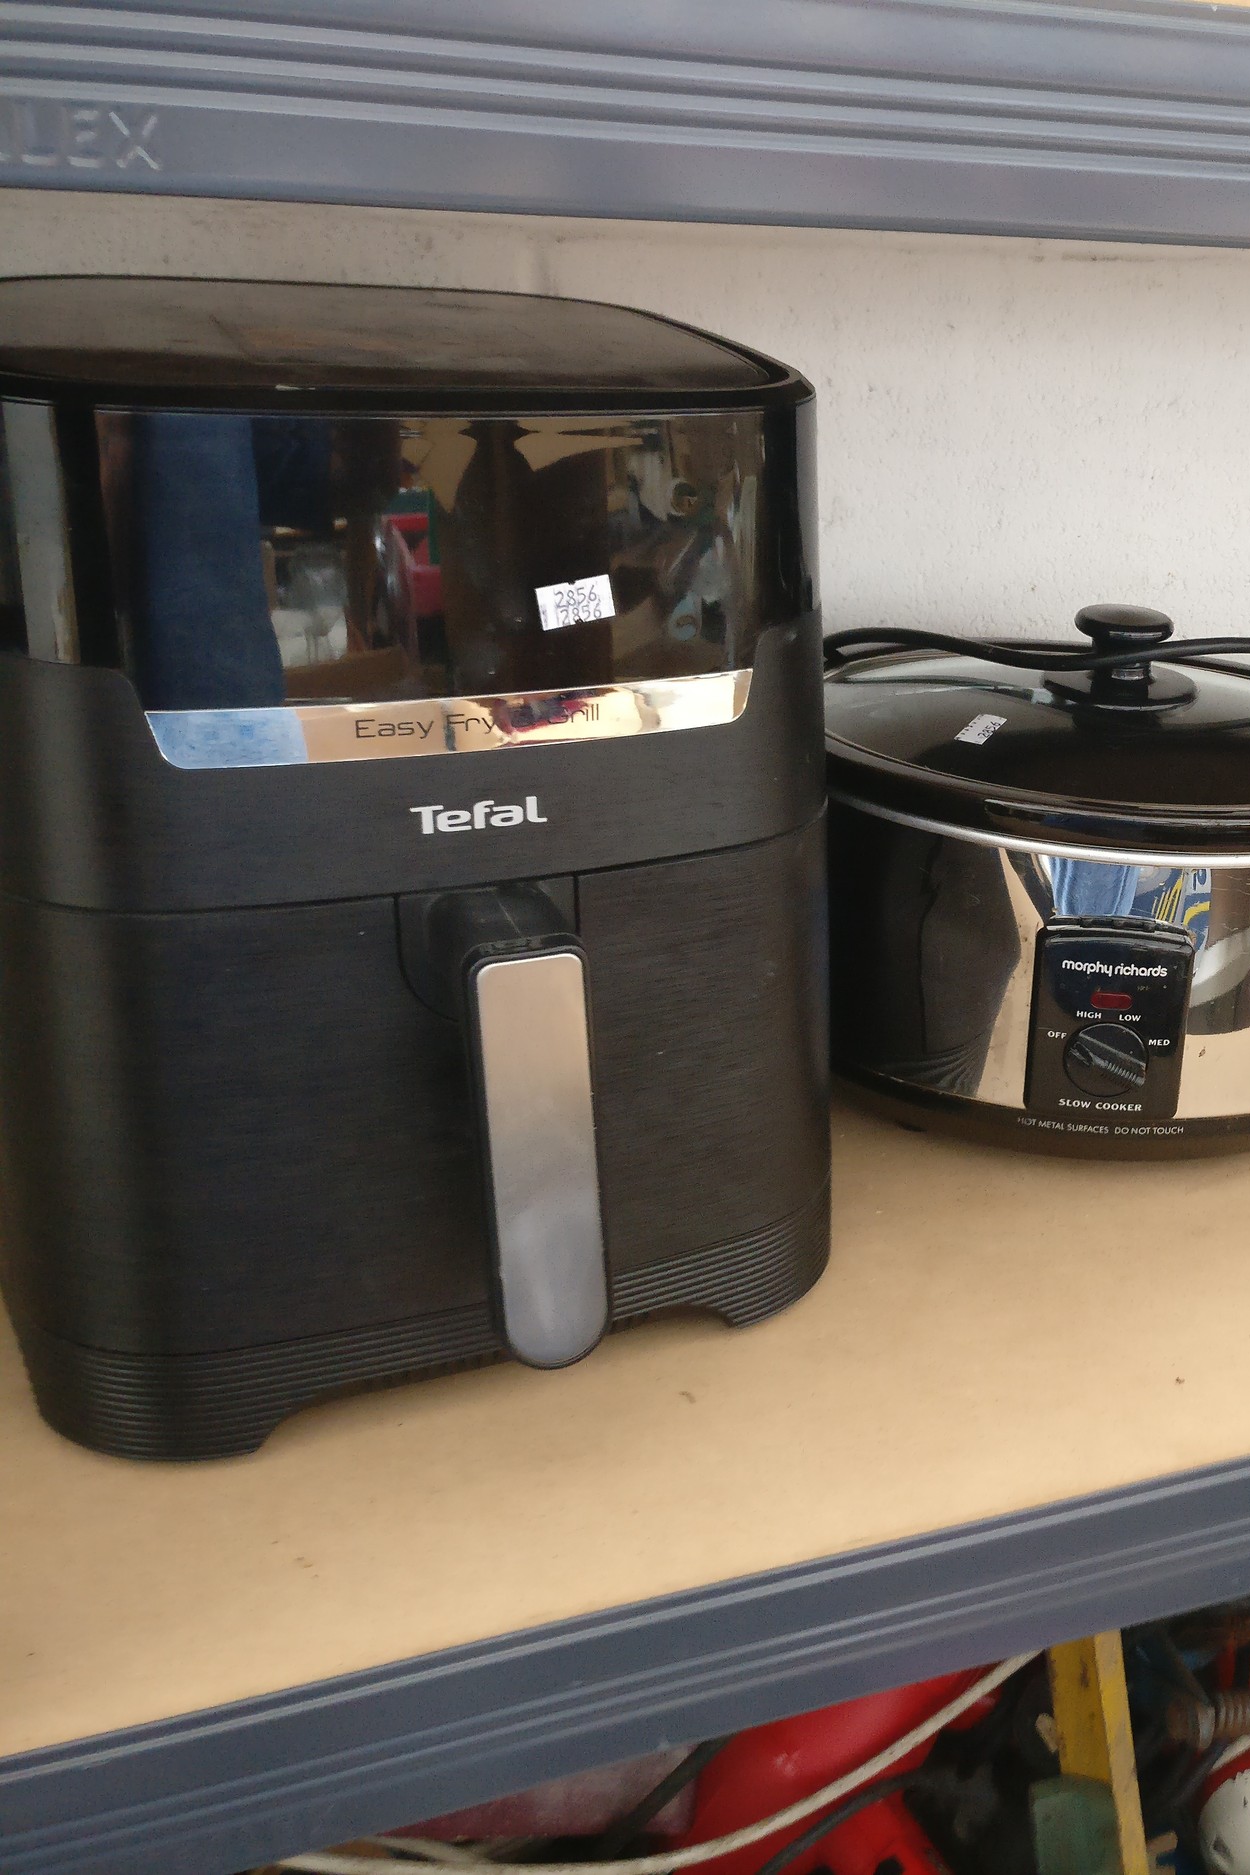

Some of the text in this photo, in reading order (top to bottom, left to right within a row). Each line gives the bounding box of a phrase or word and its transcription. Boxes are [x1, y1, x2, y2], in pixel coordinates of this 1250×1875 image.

[0, 103, 161, 171] LEX
[554, 584, 598, 609] 2856
[355, 719, 434, 739] Easy
[446, 713, 495, 735] Fry
[410, 795, 548, 836] Tefal
[1062, 959, 1168, 978] morphy richards
[1076, 1010, 1102, 1020] HIGH
[1119, 1014, 1142, 1022] LOW
[1047, 1030, 1068, 1040] OFF
[1148, 1039, 1171, 1047] MED
[1058, 1098, 1143, 1112] SLOW COOKER
[1038, 1120, 1065, 1131] METAL
[1067, 1123, 1109, 1135] SURFACES
[1114, 1126, 1129, 1135] DO
[1131, 1125, 1151, 1136] NOT
[1153, 1125, 1184, 1136] TOUCH
